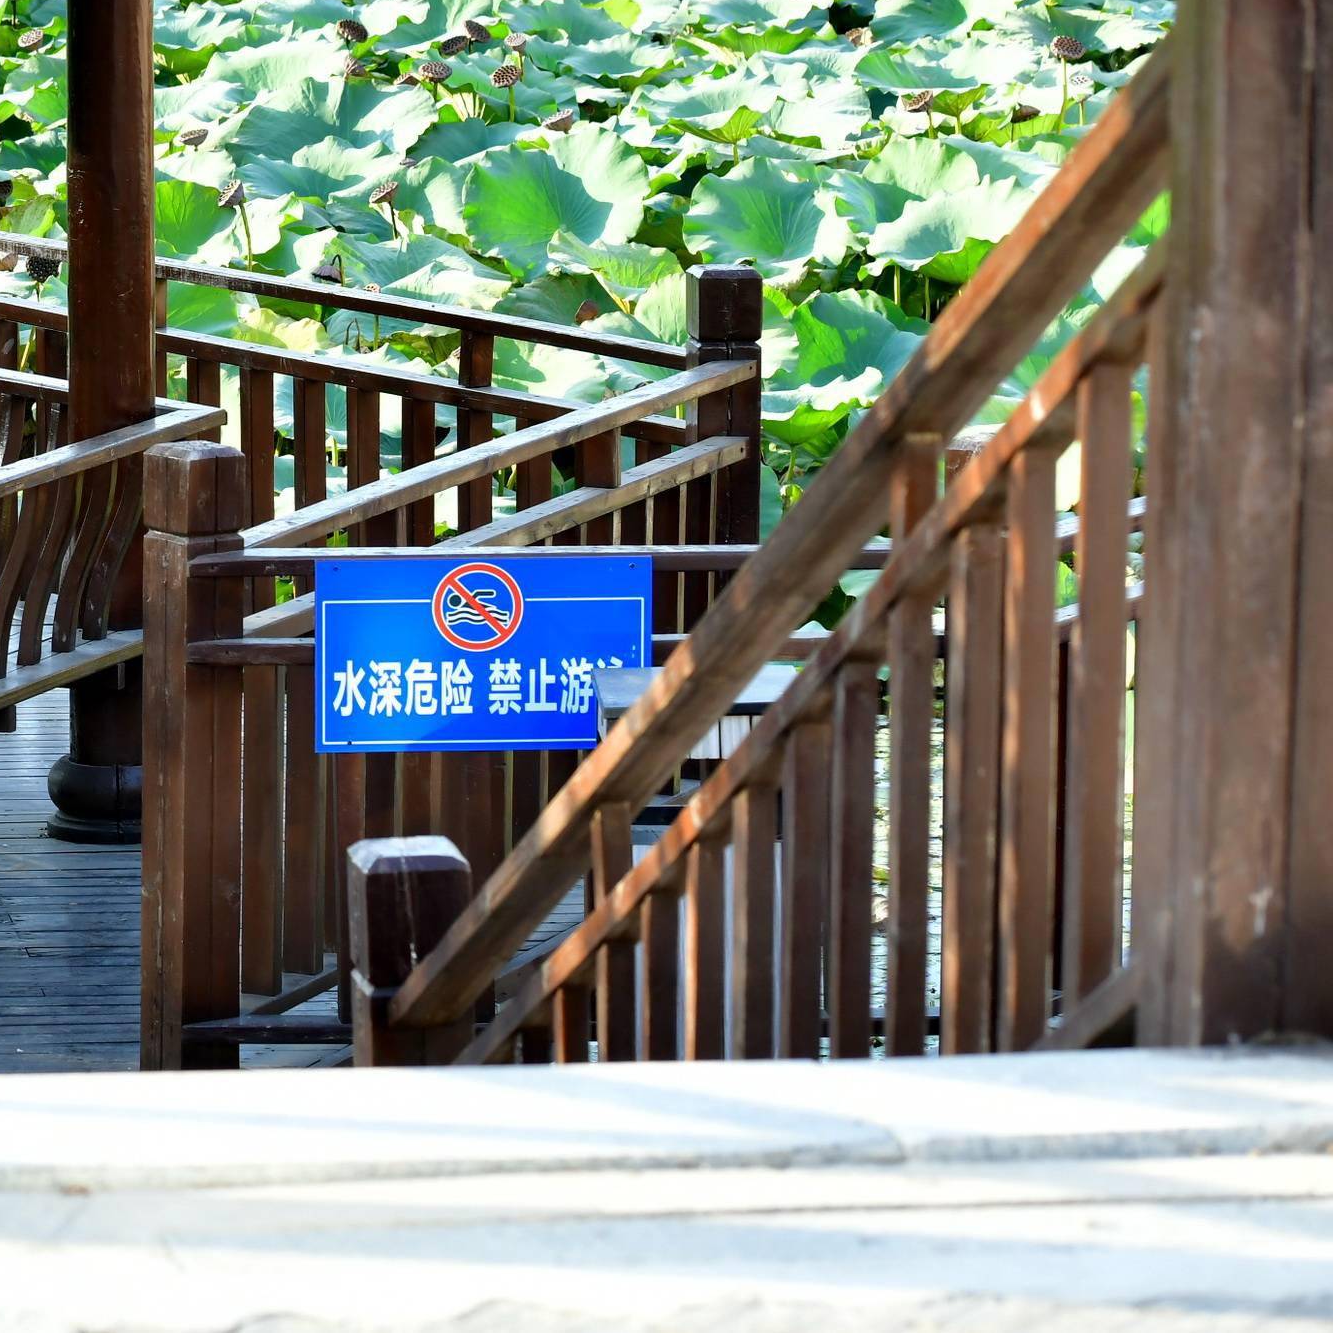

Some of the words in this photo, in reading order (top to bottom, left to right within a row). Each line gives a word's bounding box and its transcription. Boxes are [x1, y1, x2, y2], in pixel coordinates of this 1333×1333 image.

[332, 659, 474, 717] 水深危险
[488, 657, 623, 715] 禁止游
